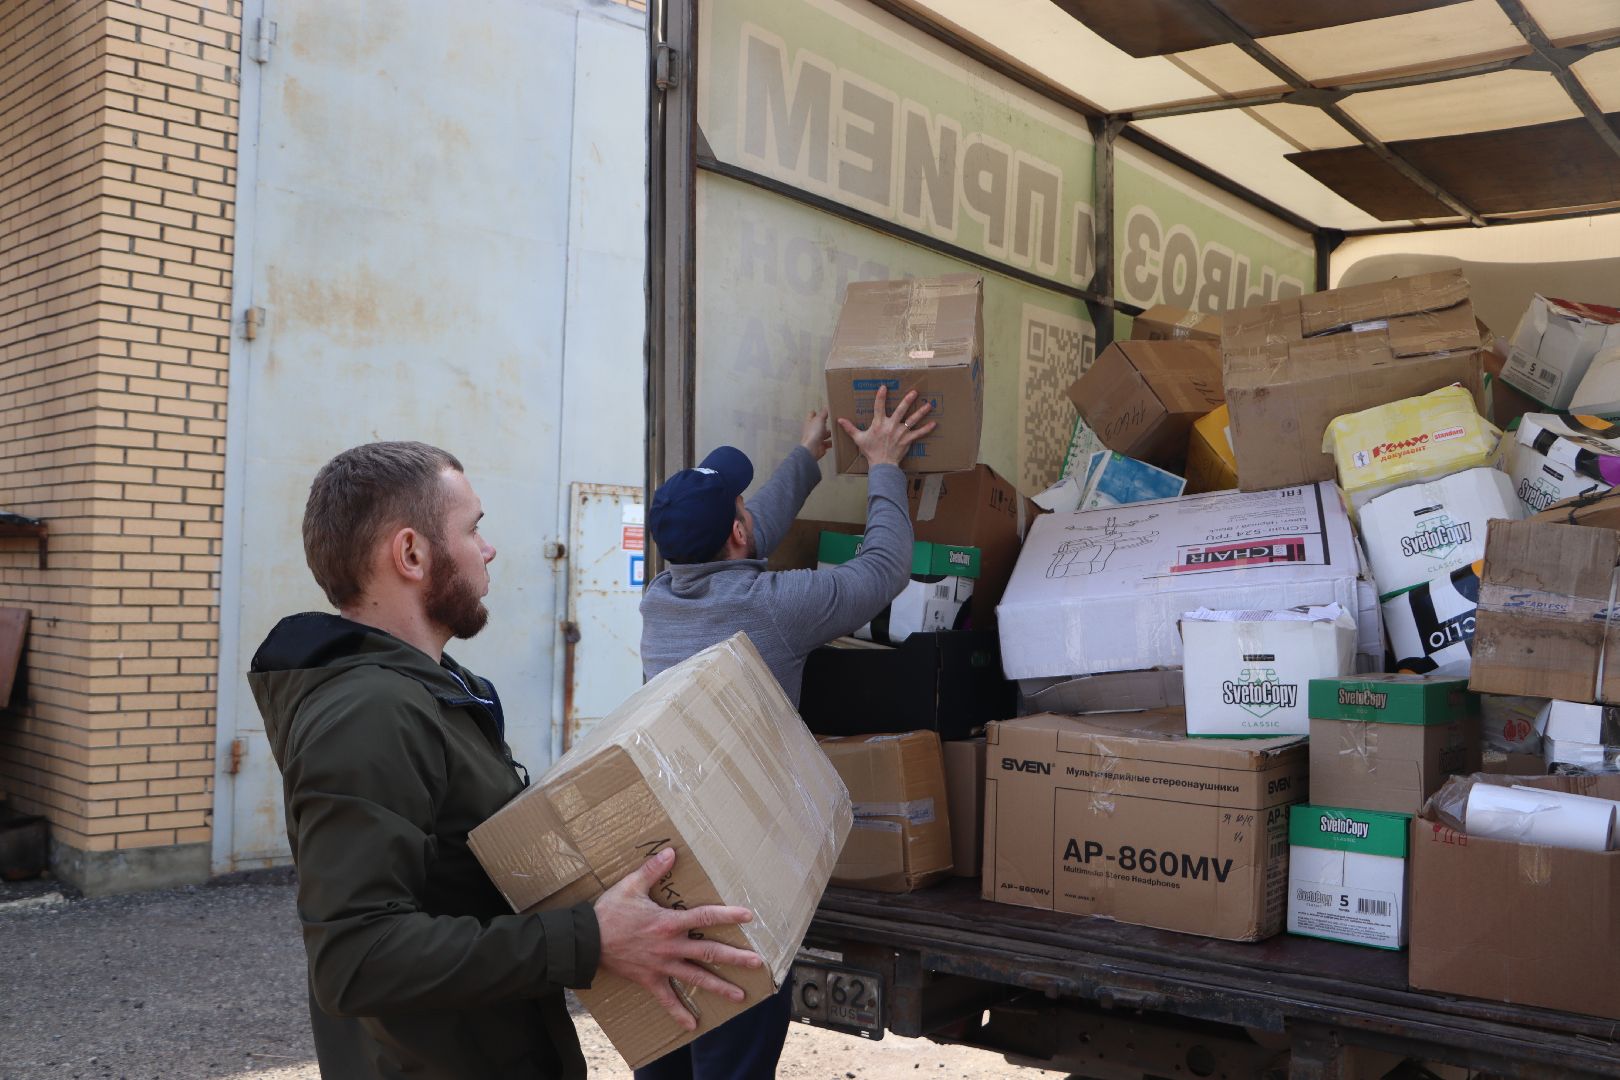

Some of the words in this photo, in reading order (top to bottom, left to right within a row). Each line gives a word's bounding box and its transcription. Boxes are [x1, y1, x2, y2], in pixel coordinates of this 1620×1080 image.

[1434, 428, 1464, 440] standard
[1518, 478, 1557, 512] SvetoC
[1401, 521, 1472, 557] SvetoCopy
[1190, 546, 1270, 563] CHAIR
[1427, 558, 1463, 573] CLASSIC
[1222, 680, 1298, 707] SvetoCopy
[1338, 687, 1388, 709] SvetoCopy
[1001, 757, 1051, 775] SVEN
[1152, 776, 1240, 793] стереонаушники
[1320, 815, 1369, 839] SvetoCopy
[1062, 838, 1234, 883] AP-860MV
[1105, 870, 1130, 882] Stereo
[1131, 875, 1181, 889] Headphones
[1340, 894, 1349, 907] 5
[831, 976, 866, 1009] 62
[831, 1006, 857, 1018] RUS
